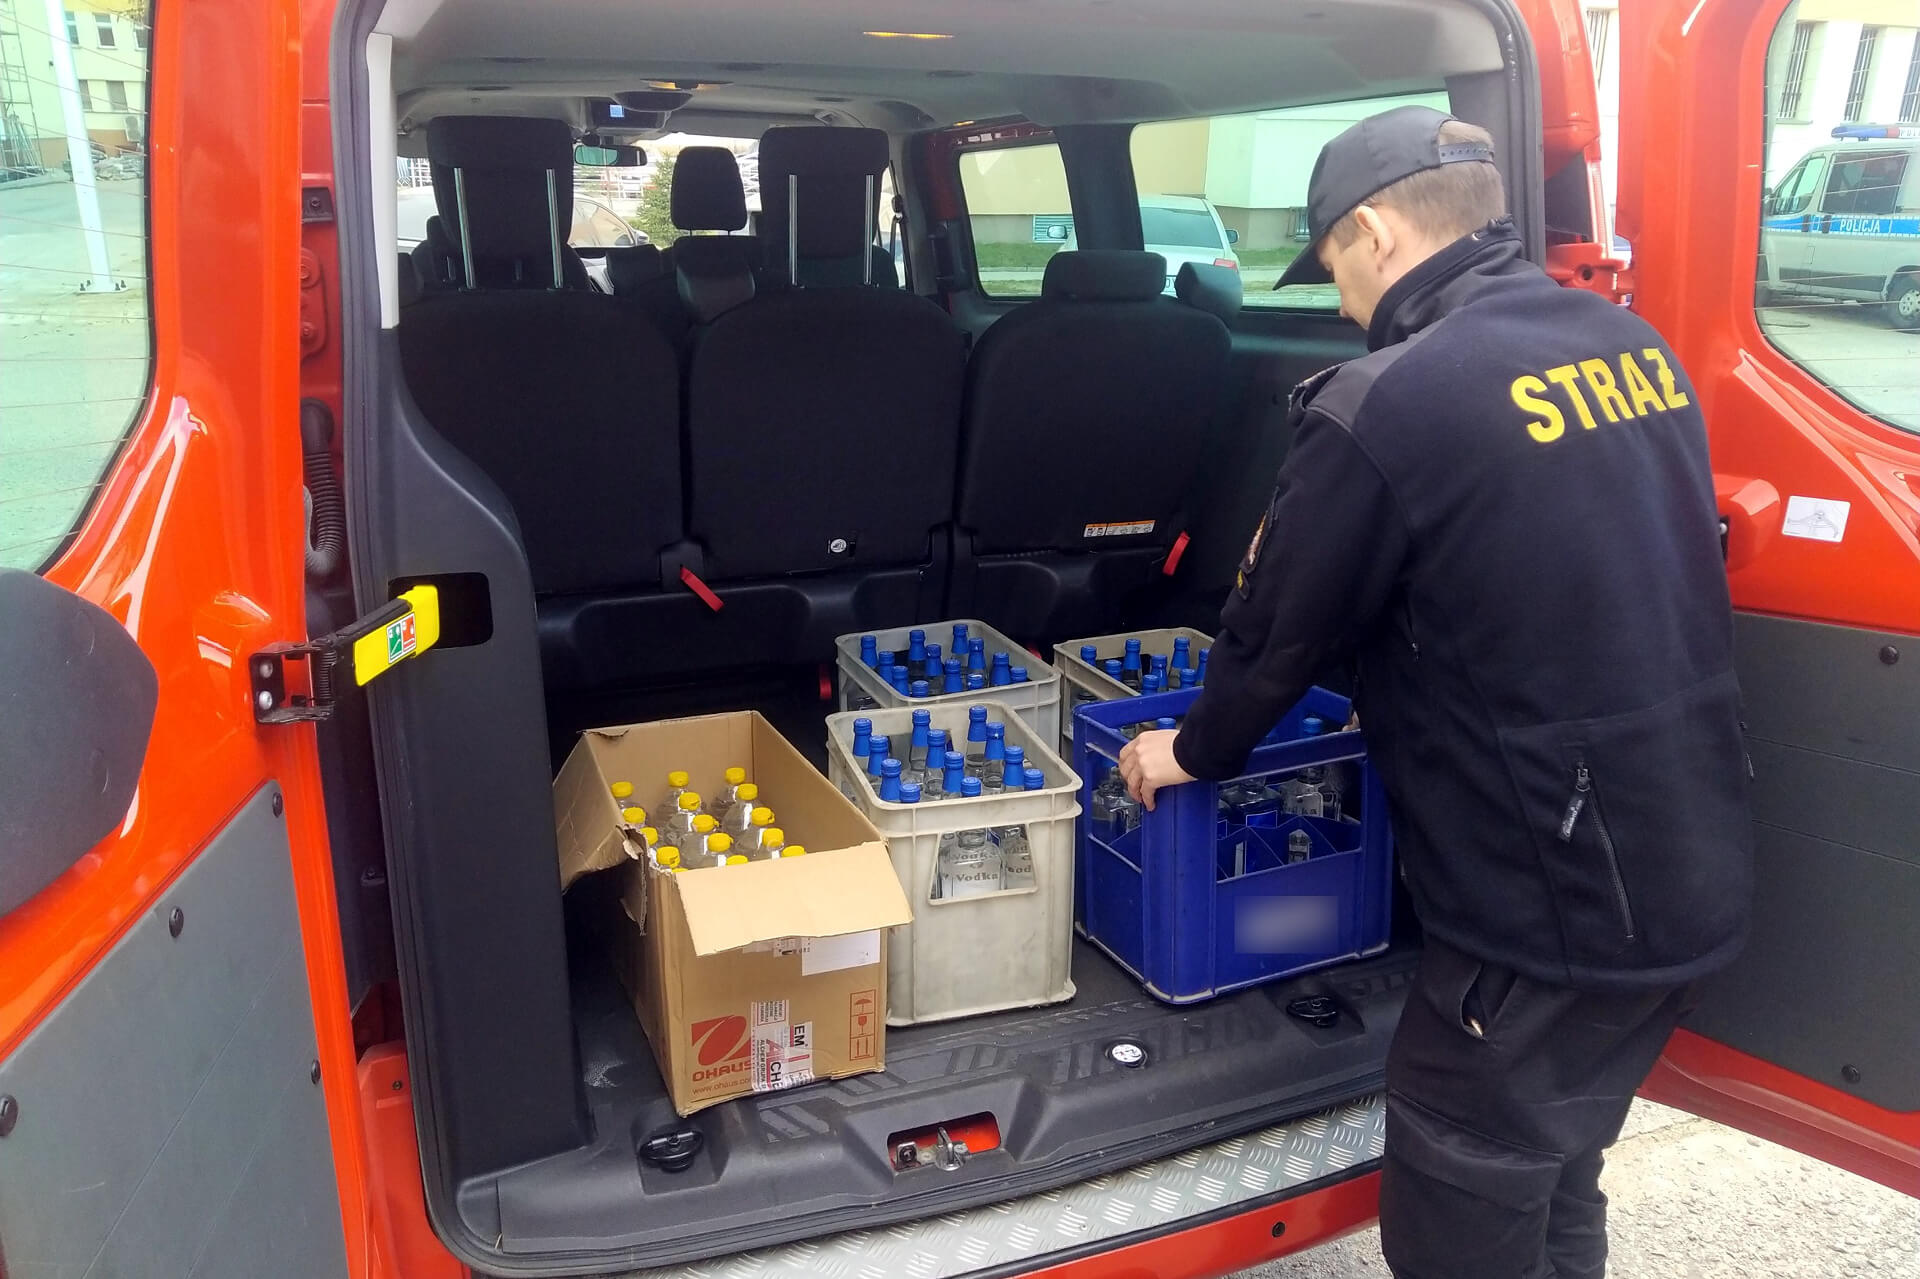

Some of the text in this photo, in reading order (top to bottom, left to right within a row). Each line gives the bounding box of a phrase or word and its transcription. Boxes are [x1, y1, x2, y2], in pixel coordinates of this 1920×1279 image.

[1840, 218, 1880, 233] POLICJA
[956, 872, 999, 882] Vodka
[692, 1060, 751, 1081] OHAUS
[692, 1078, 751, 1095] www.ohaus.co
